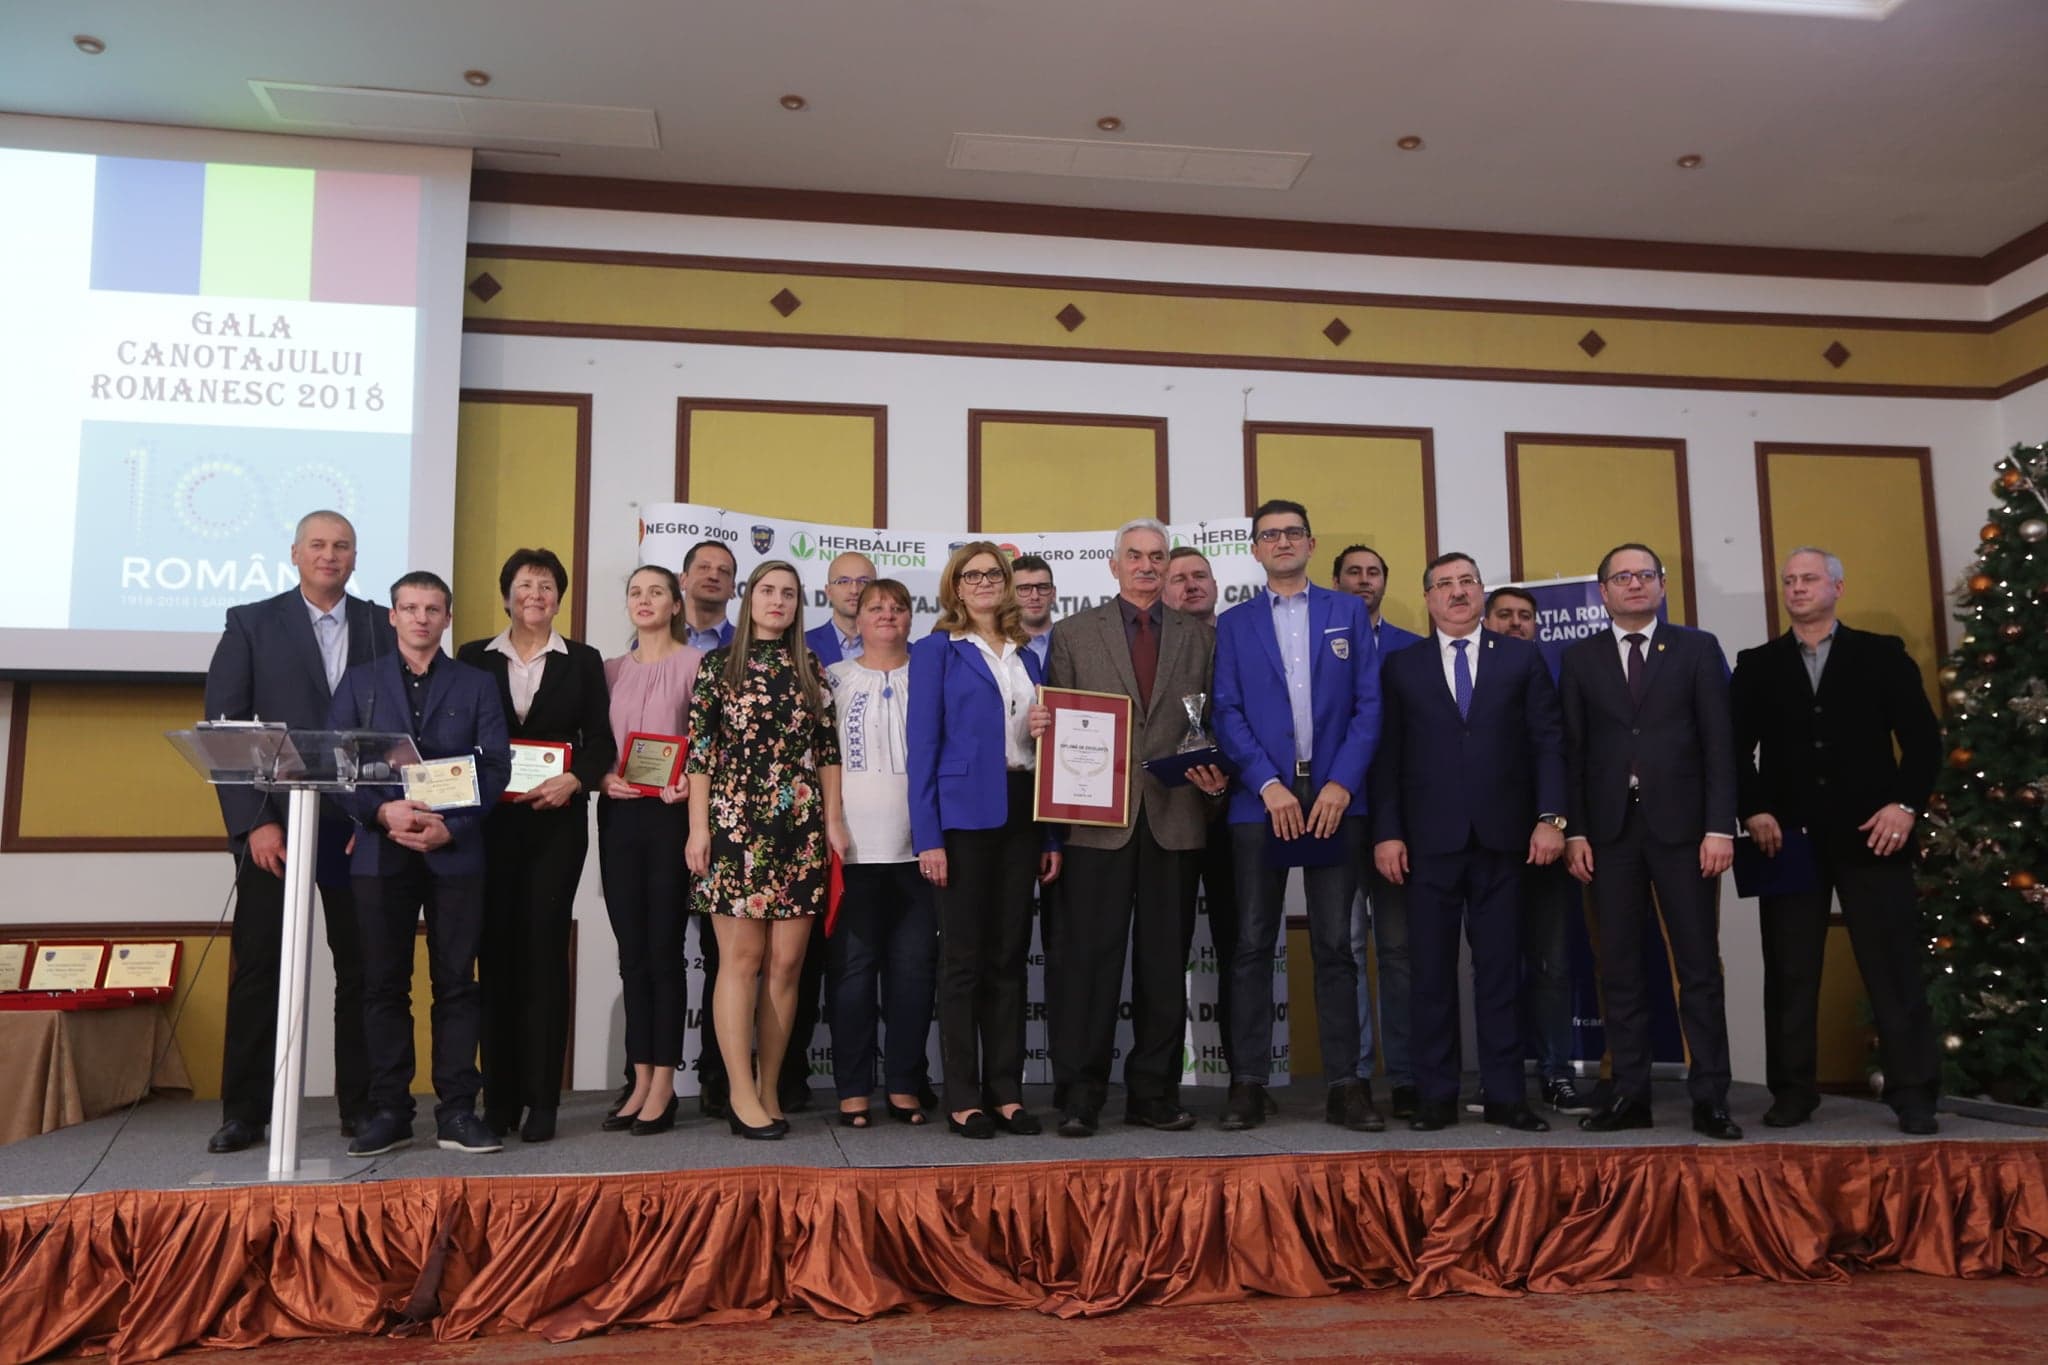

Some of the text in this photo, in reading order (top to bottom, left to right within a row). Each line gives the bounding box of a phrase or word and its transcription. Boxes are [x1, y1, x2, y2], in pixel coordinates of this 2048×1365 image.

[191, 311, 293, 340] GALA
[116, 340, 363, 377] CANOTAJULUI
[90, 373, 385, 412] ROMANESC 2018
[645, 522, 739, 542] NEGRO 2000
[819, 535, 926, 554] HERBALIFE
[1079, 549, 1114, 560] 2000
[819, 549, 926, 568] NITION
[121, 552, 362, 595] ROMÂN
